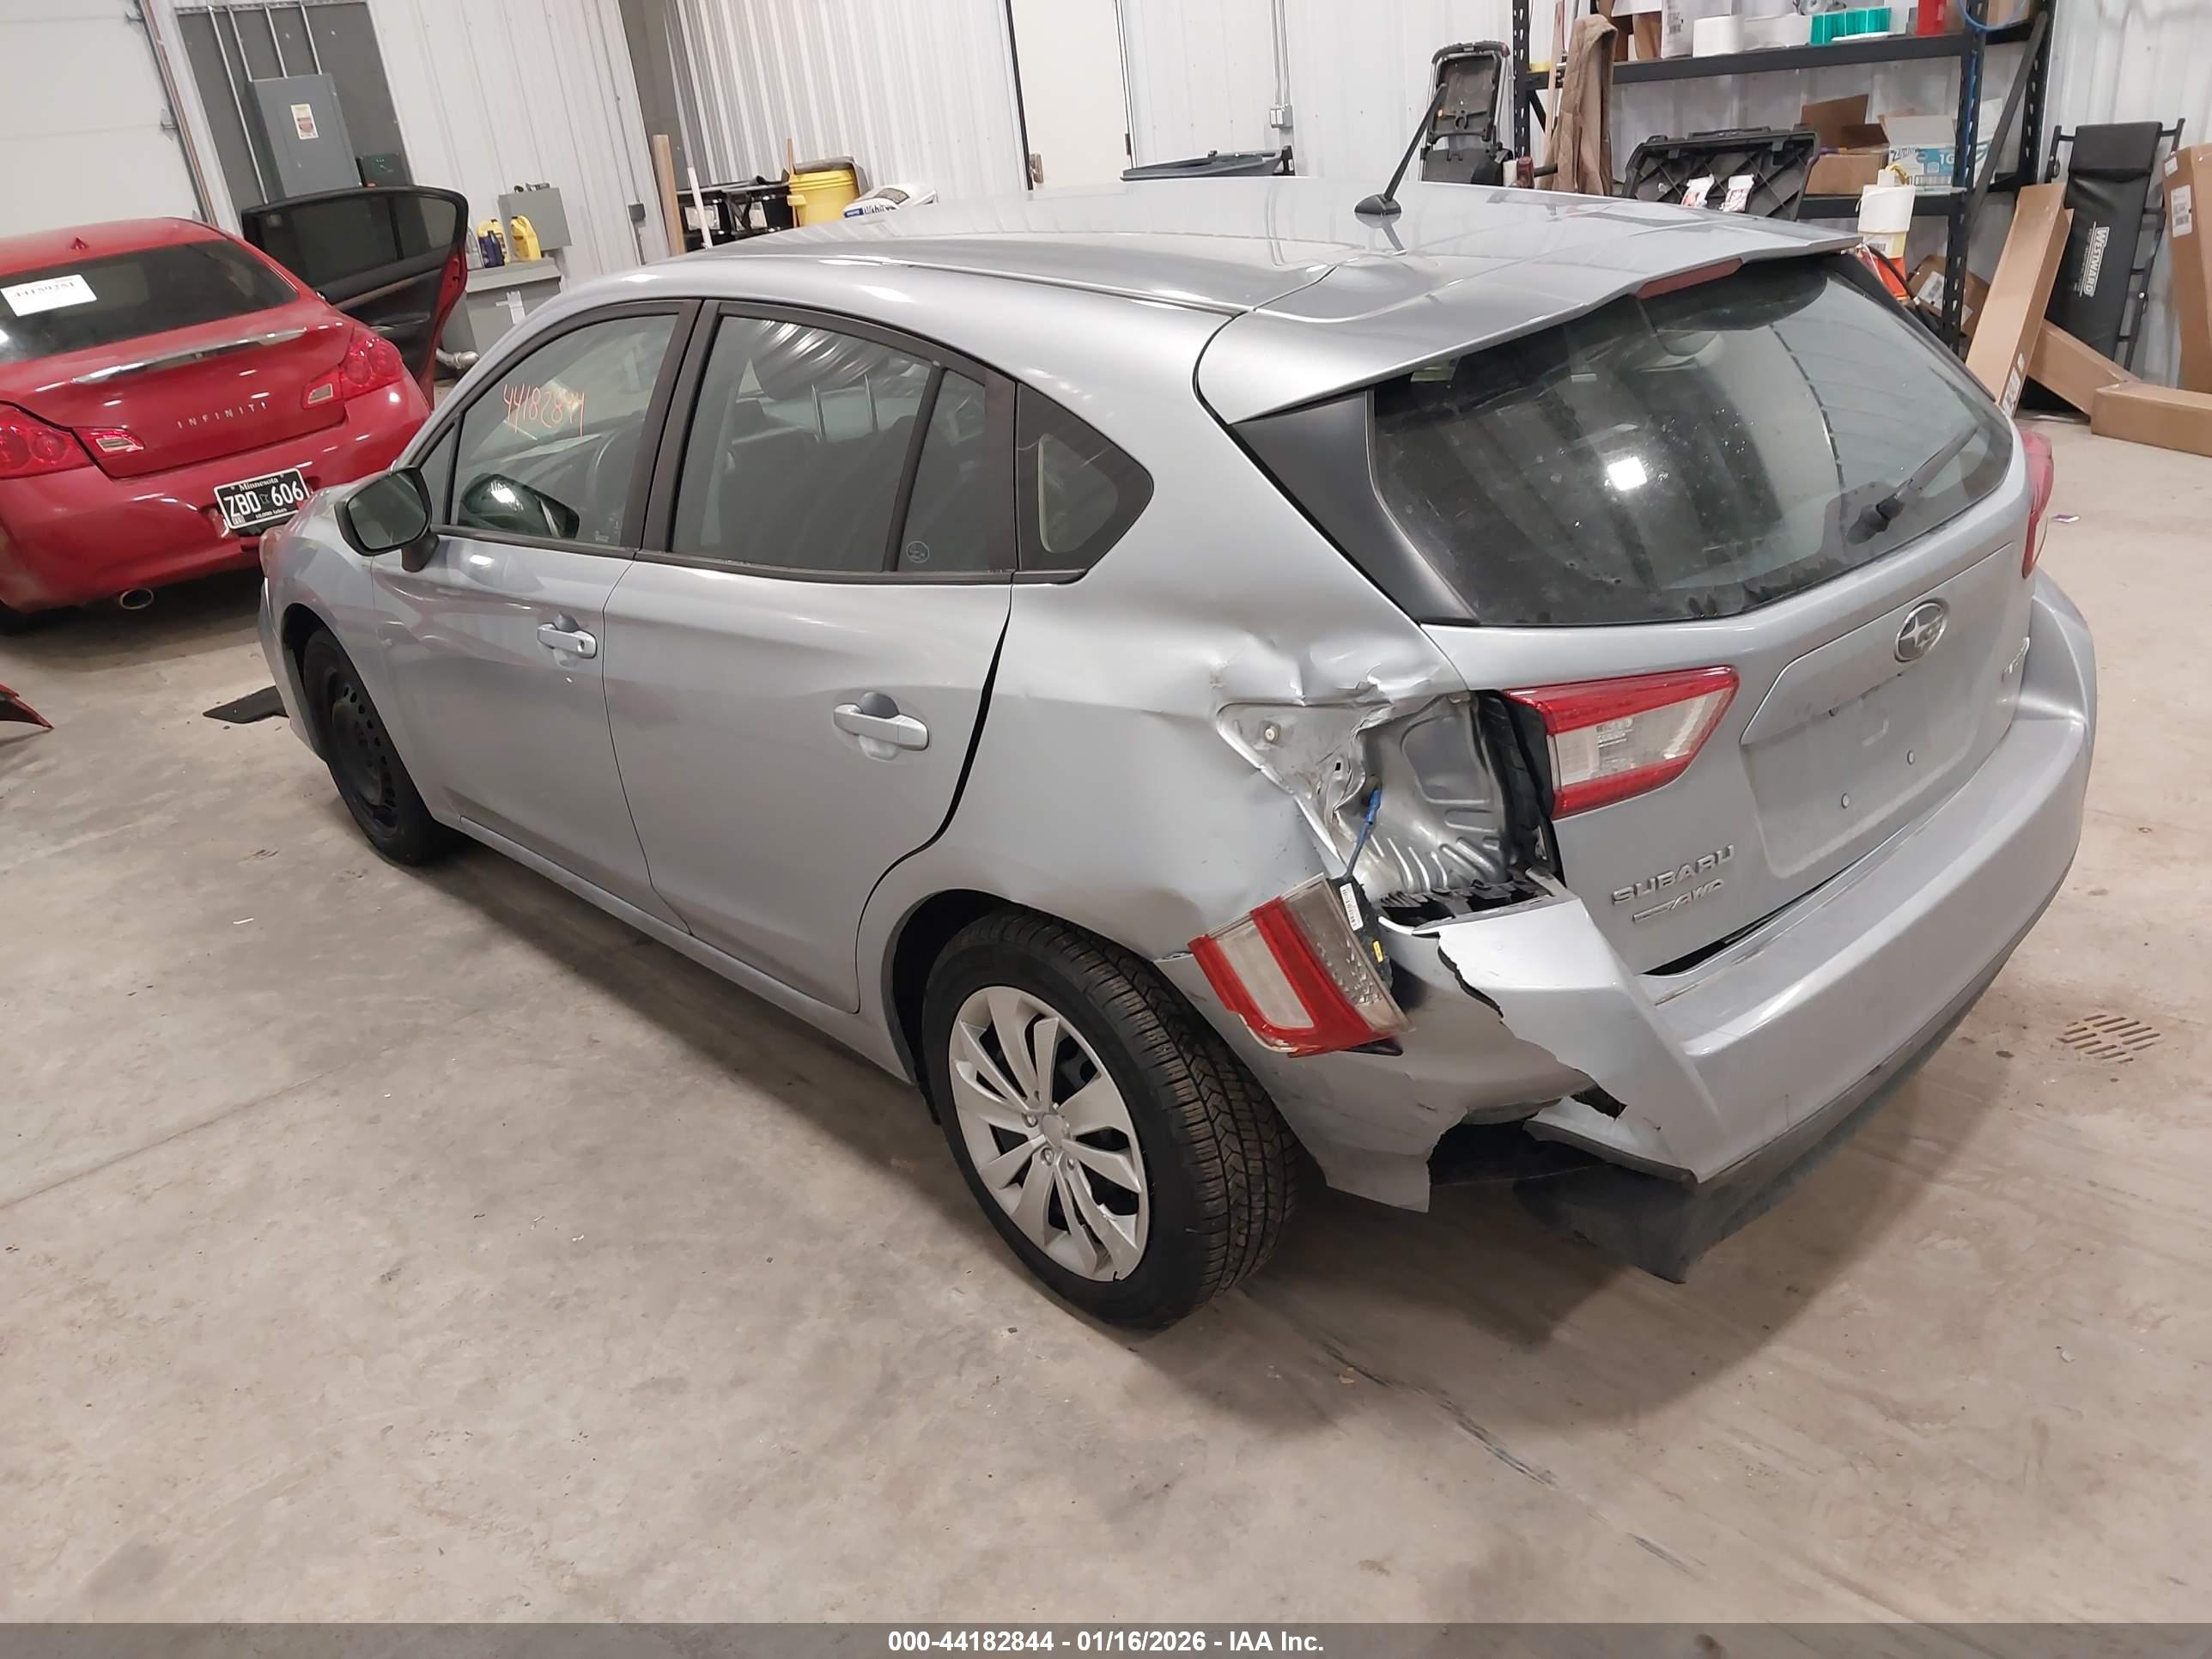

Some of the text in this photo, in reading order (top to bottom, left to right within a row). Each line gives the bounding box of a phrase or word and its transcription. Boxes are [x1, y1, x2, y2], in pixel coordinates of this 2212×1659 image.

[2084, 228, 2108, 294] WESTWARD
[177, 401, 267, 429] INFINITI
[223, 481, 304, 518] ZBD 606
[239, 477, 279, 491] Minnesota
[1612, 844, 1735, 905] SUBARU
